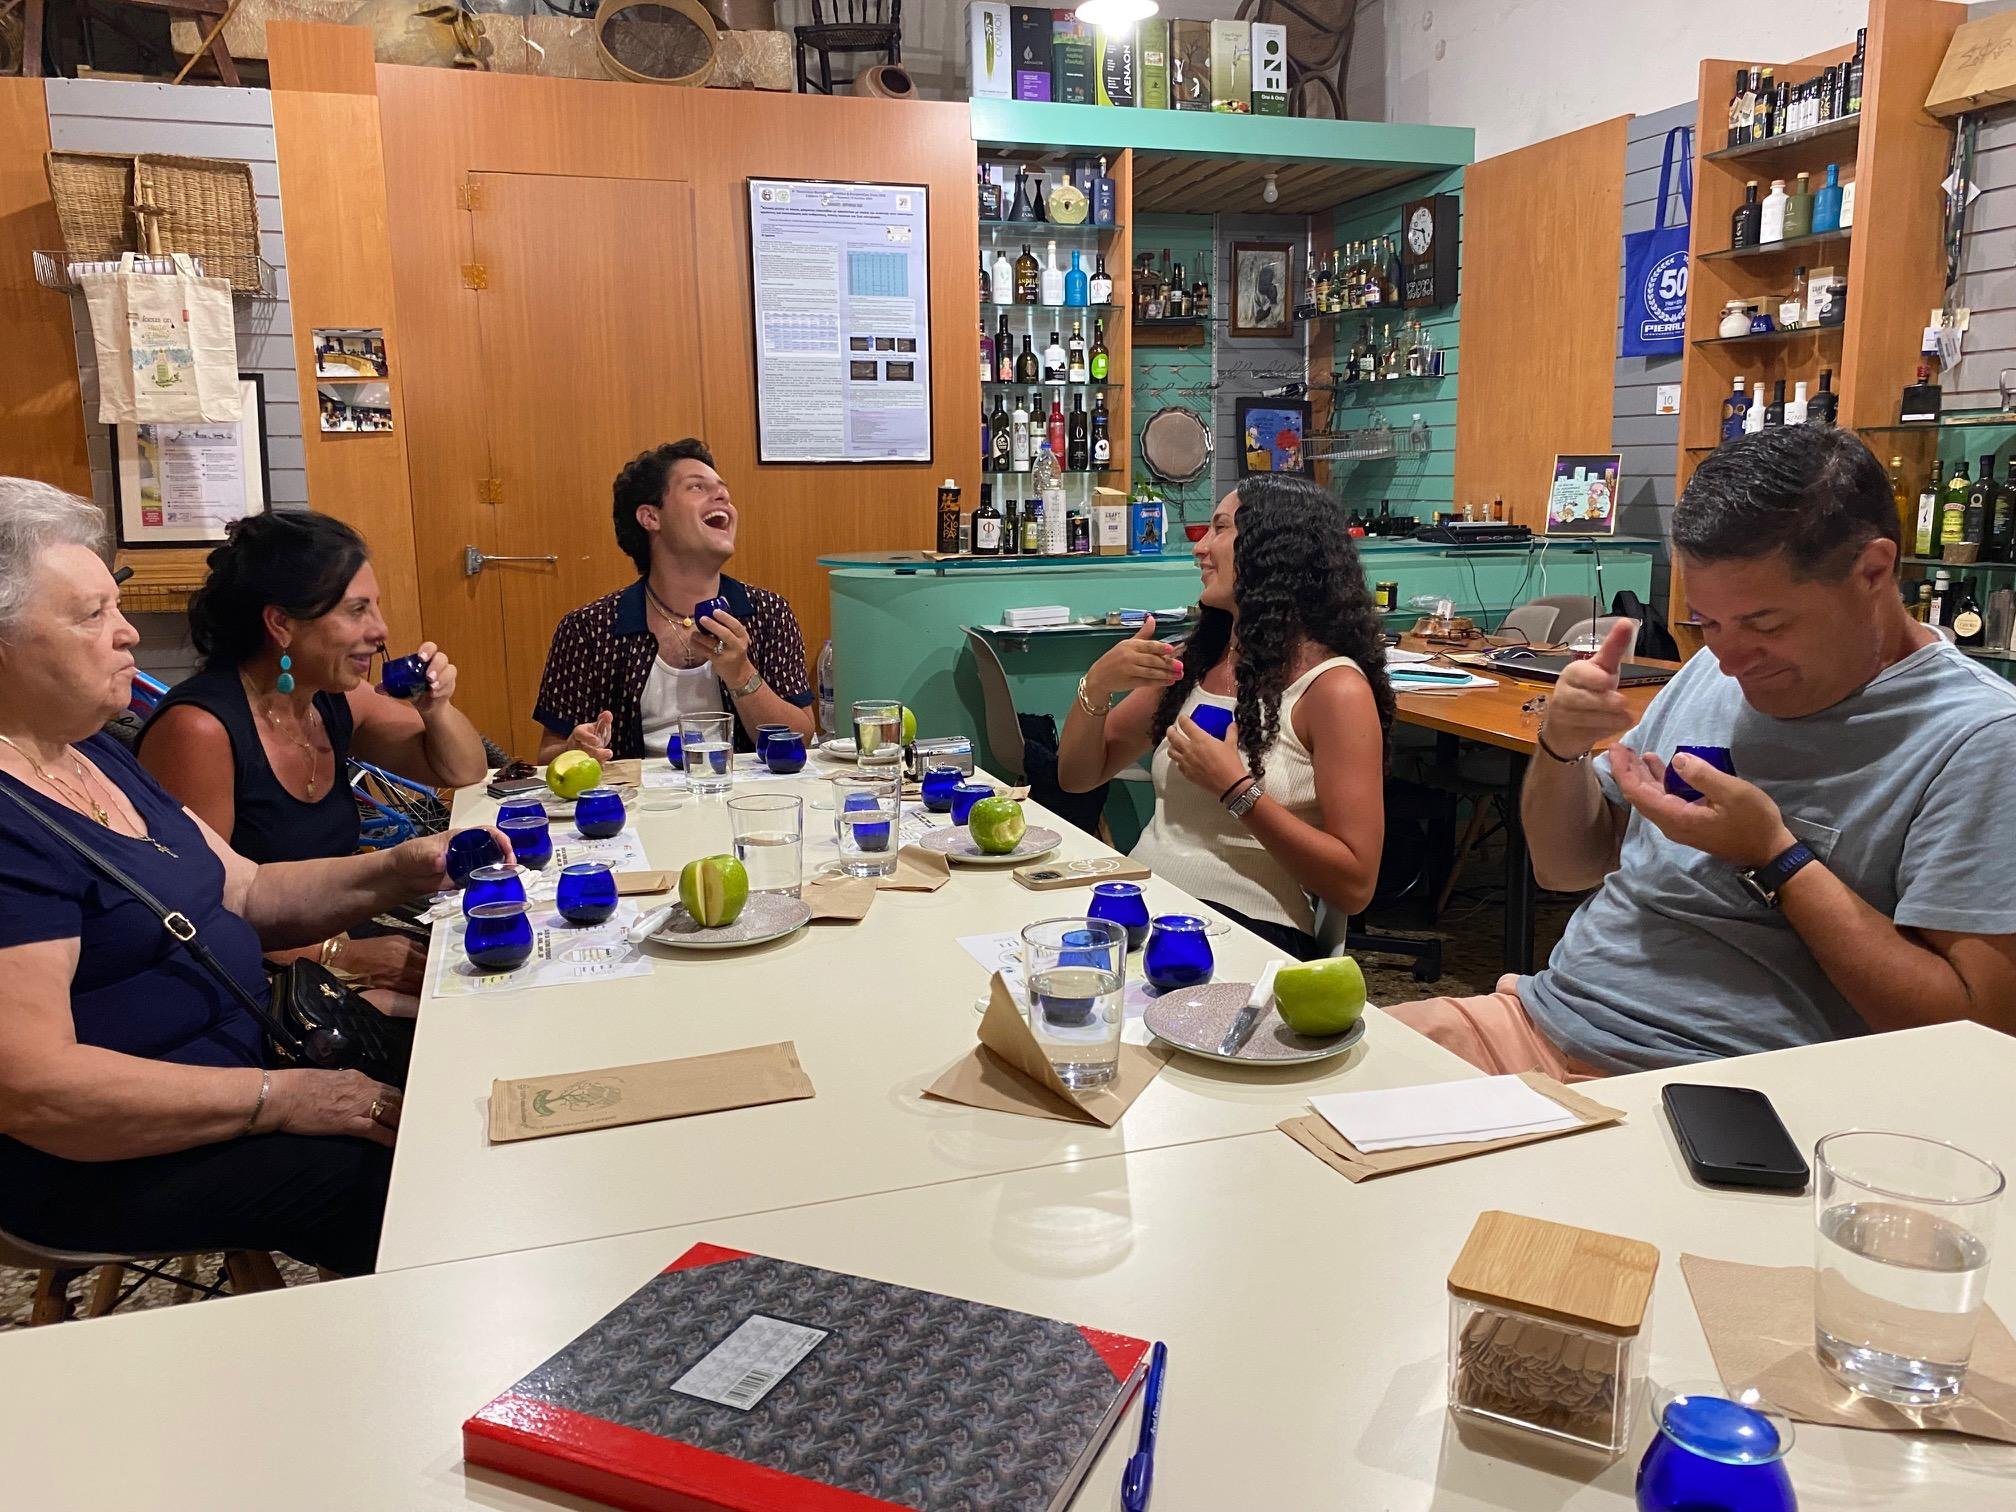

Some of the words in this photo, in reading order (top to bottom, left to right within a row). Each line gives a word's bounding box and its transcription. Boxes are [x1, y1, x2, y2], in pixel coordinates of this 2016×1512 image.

[1123, 45, 1132, 95] AENAON
[1659, 267, 1688, 299] 50
[142, 315, 161, 323] focus
